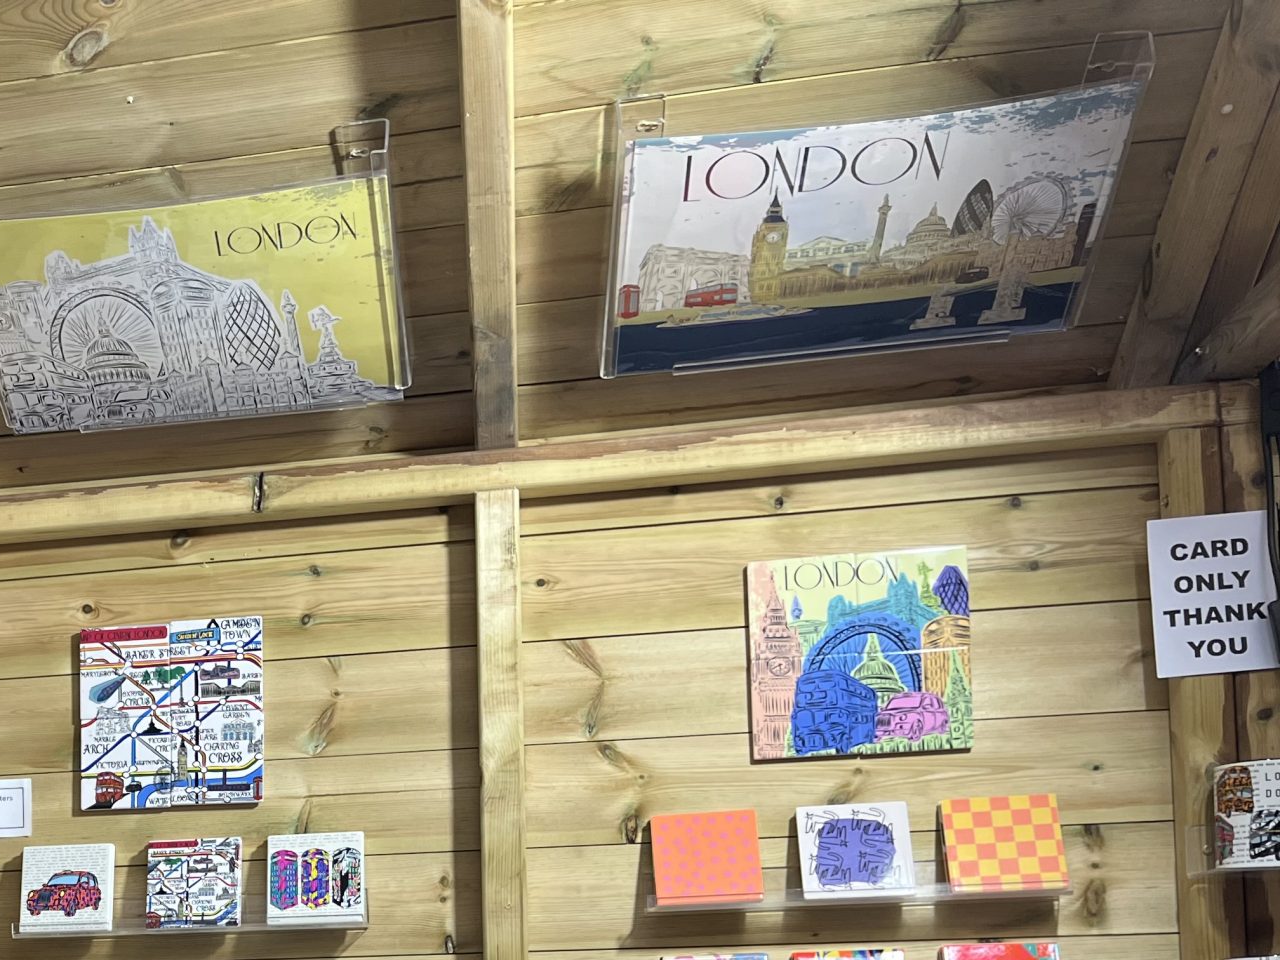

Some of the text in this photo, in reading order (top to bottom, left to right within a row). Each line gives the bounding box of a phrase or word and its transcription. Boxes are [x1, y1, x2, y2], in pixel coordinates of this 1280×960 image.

[682, 130, 950, 203] LONDON
[214, 212, 358, 257] LONDON
[1170, 537, 1249, 561] CARD
[784, 556, 899, 591] LONDON
[1174, 569, 1251, 594] ONLY
[1163, 601, 1268, 627] THANK
[224, 629, 251, 640] TOWN
[125, 646, 193, 660] BAKER STREET
[1187, 637, 1248, 658] YOU
[83, 743, 110, 755] ARCH
[209, 751, 243, 764] CROSS
[95, 760, 128, 769] VICTORIA
